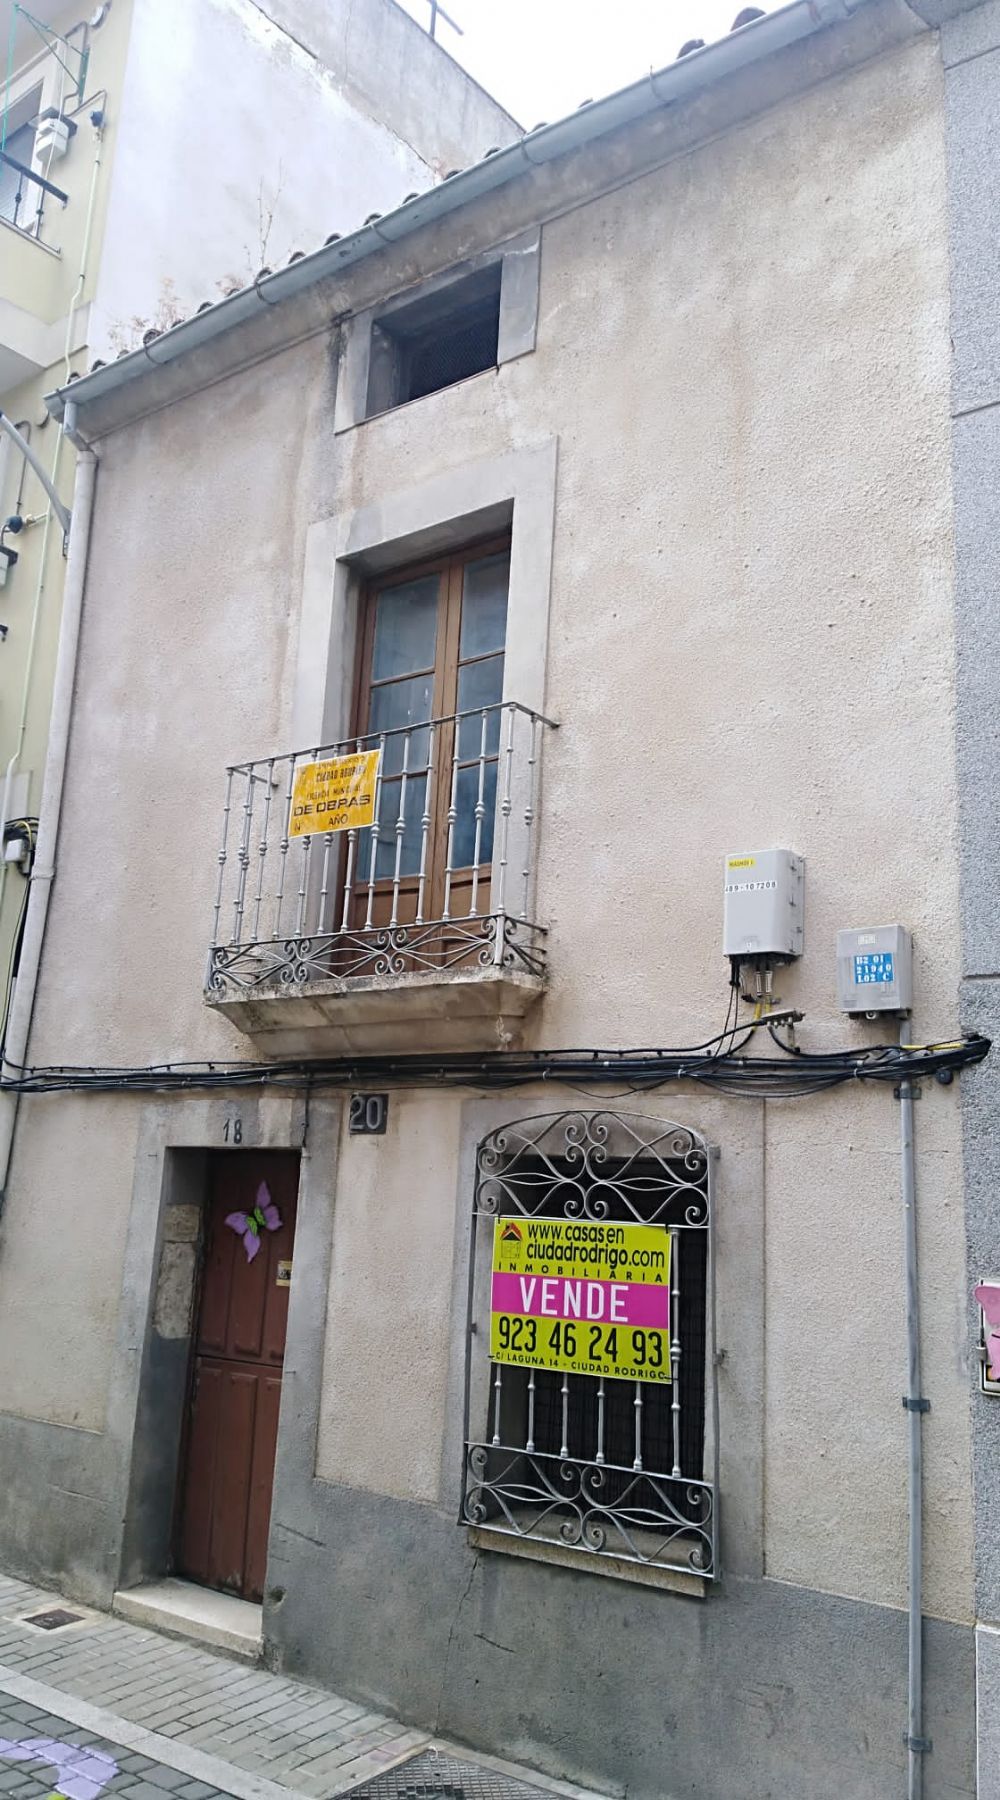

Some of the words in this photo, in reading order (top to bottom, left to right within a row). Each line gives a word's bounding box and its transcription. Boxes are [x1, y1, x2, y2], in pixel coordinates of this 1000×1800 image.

[294, 804, 313, 817] DE
[316, 794, 371, 813] OBRAS
[328, 812, 349, 826] AÑO
[883, 972, 890, 981] C
[351, 1096, 383, 1130] 20
[223, 1118, 242, 1144] 18
[526, 1239, 665, 1270] ciudadrodrigo.com
[498, 1261, 664, 1283] INMOBILIARIA
[519, 1276, 629, 1323] VENDE
[499, 1316, 537, 1353] 923
[548, 1321, 577, 1358] 46
[588, 1325, 619, 1363] 24
[632, 1330, 663, 1367] 93
[507, 1353, 545, 1366] LAGUNA
[549, 1360, 559, 1368] 14
[571, 1361, 610, 1374] CIUDAD
[614, 1366, 666, 1380] RODRIGO
